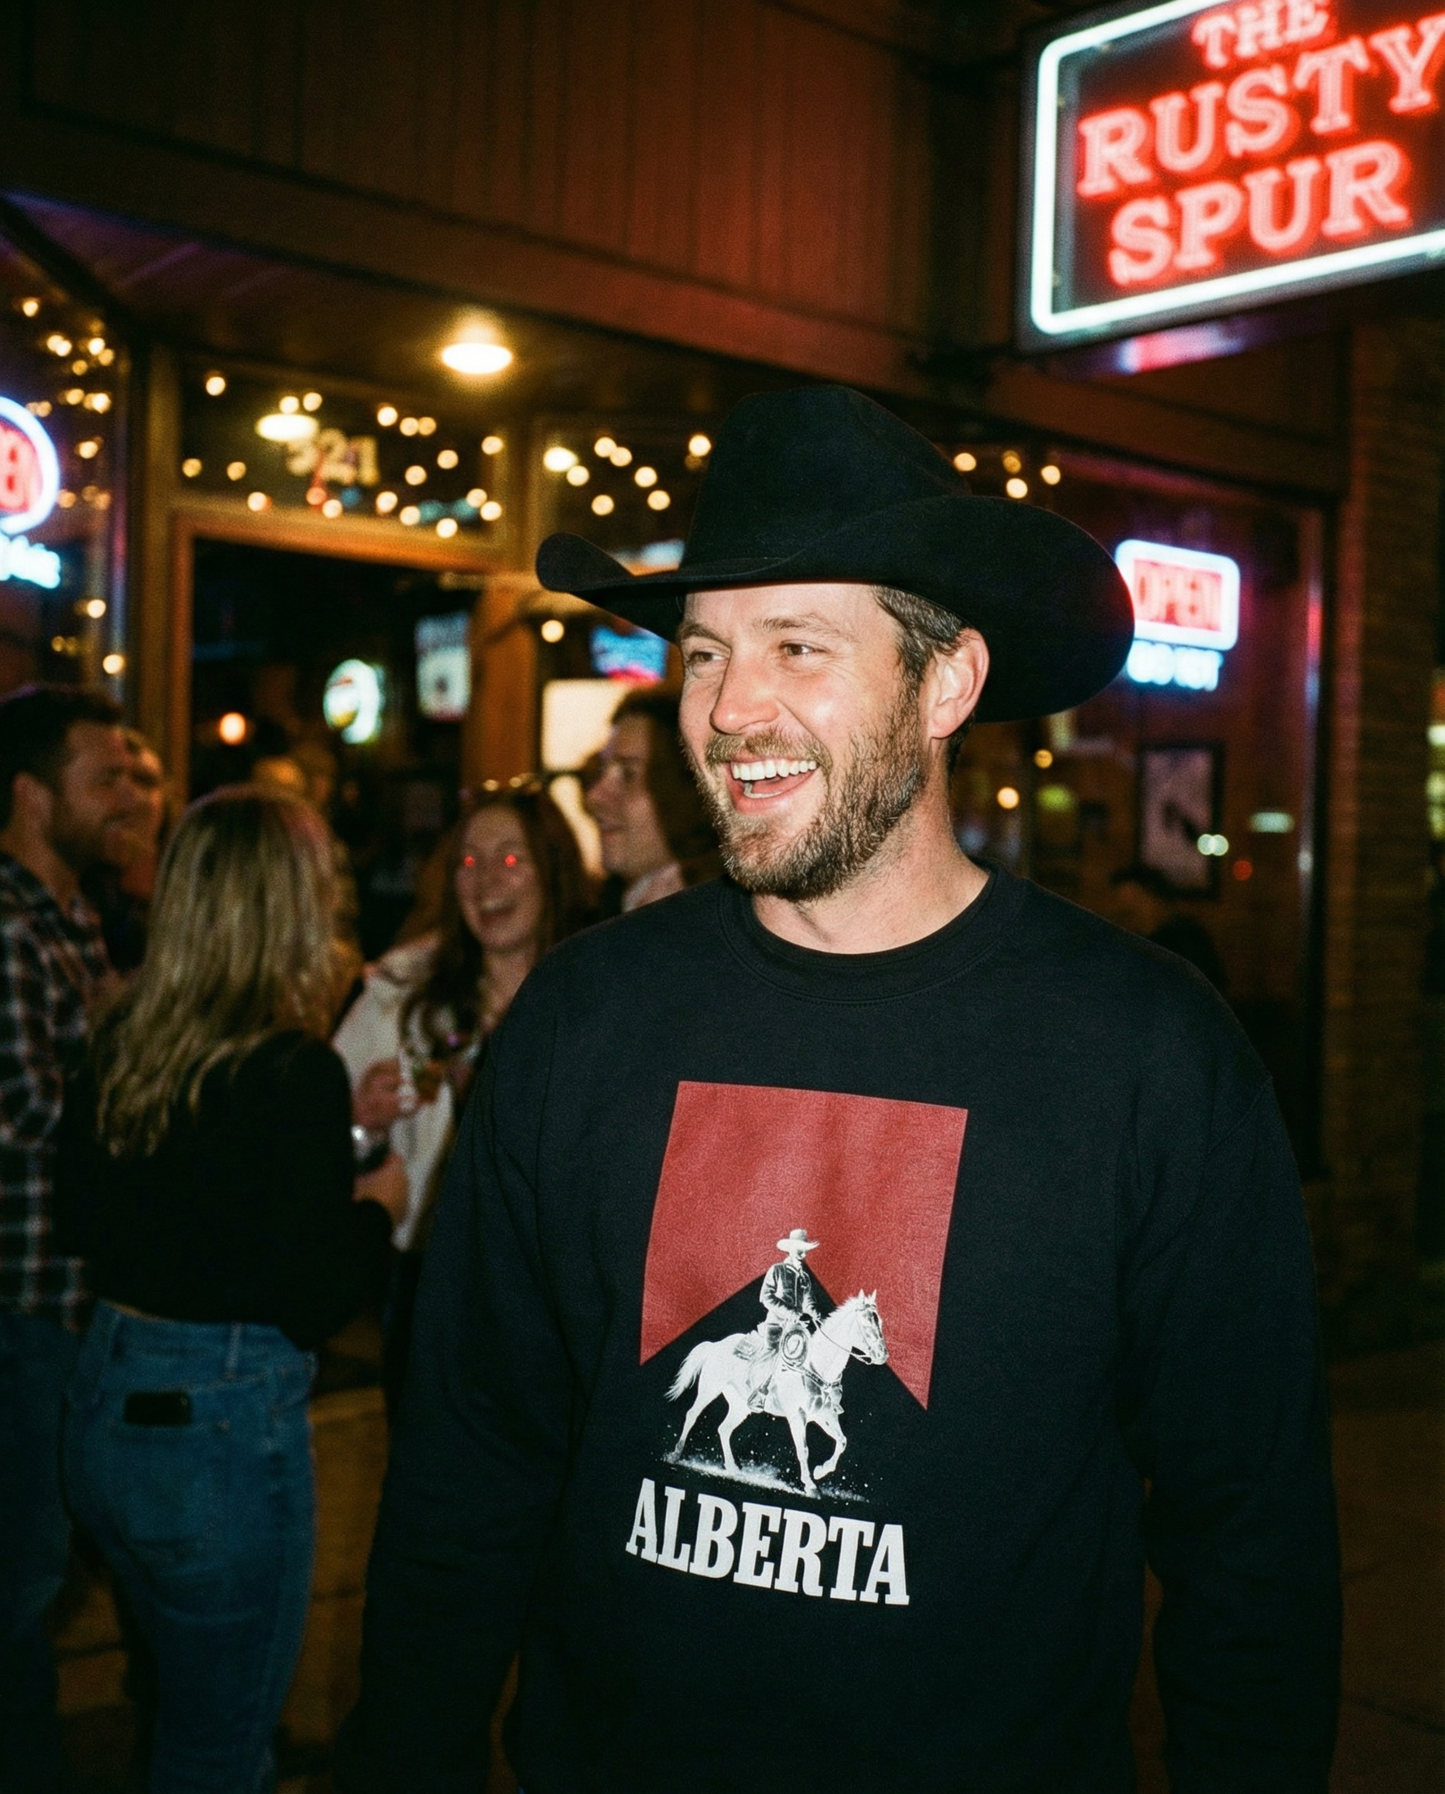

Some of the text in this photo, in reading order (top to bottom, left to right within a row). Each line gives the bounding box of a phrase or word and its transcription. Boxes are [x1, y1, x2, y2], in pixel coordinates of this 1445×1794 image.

[1191, 0, 1331, 68] THE
[1076, 13, 1445, 197] RUSTY
[1108, 140, 1410, 286] SPUR
[1131, 558, 1223, 633] OPEN
[625, 1477, 910, 1606] ALBERTA
